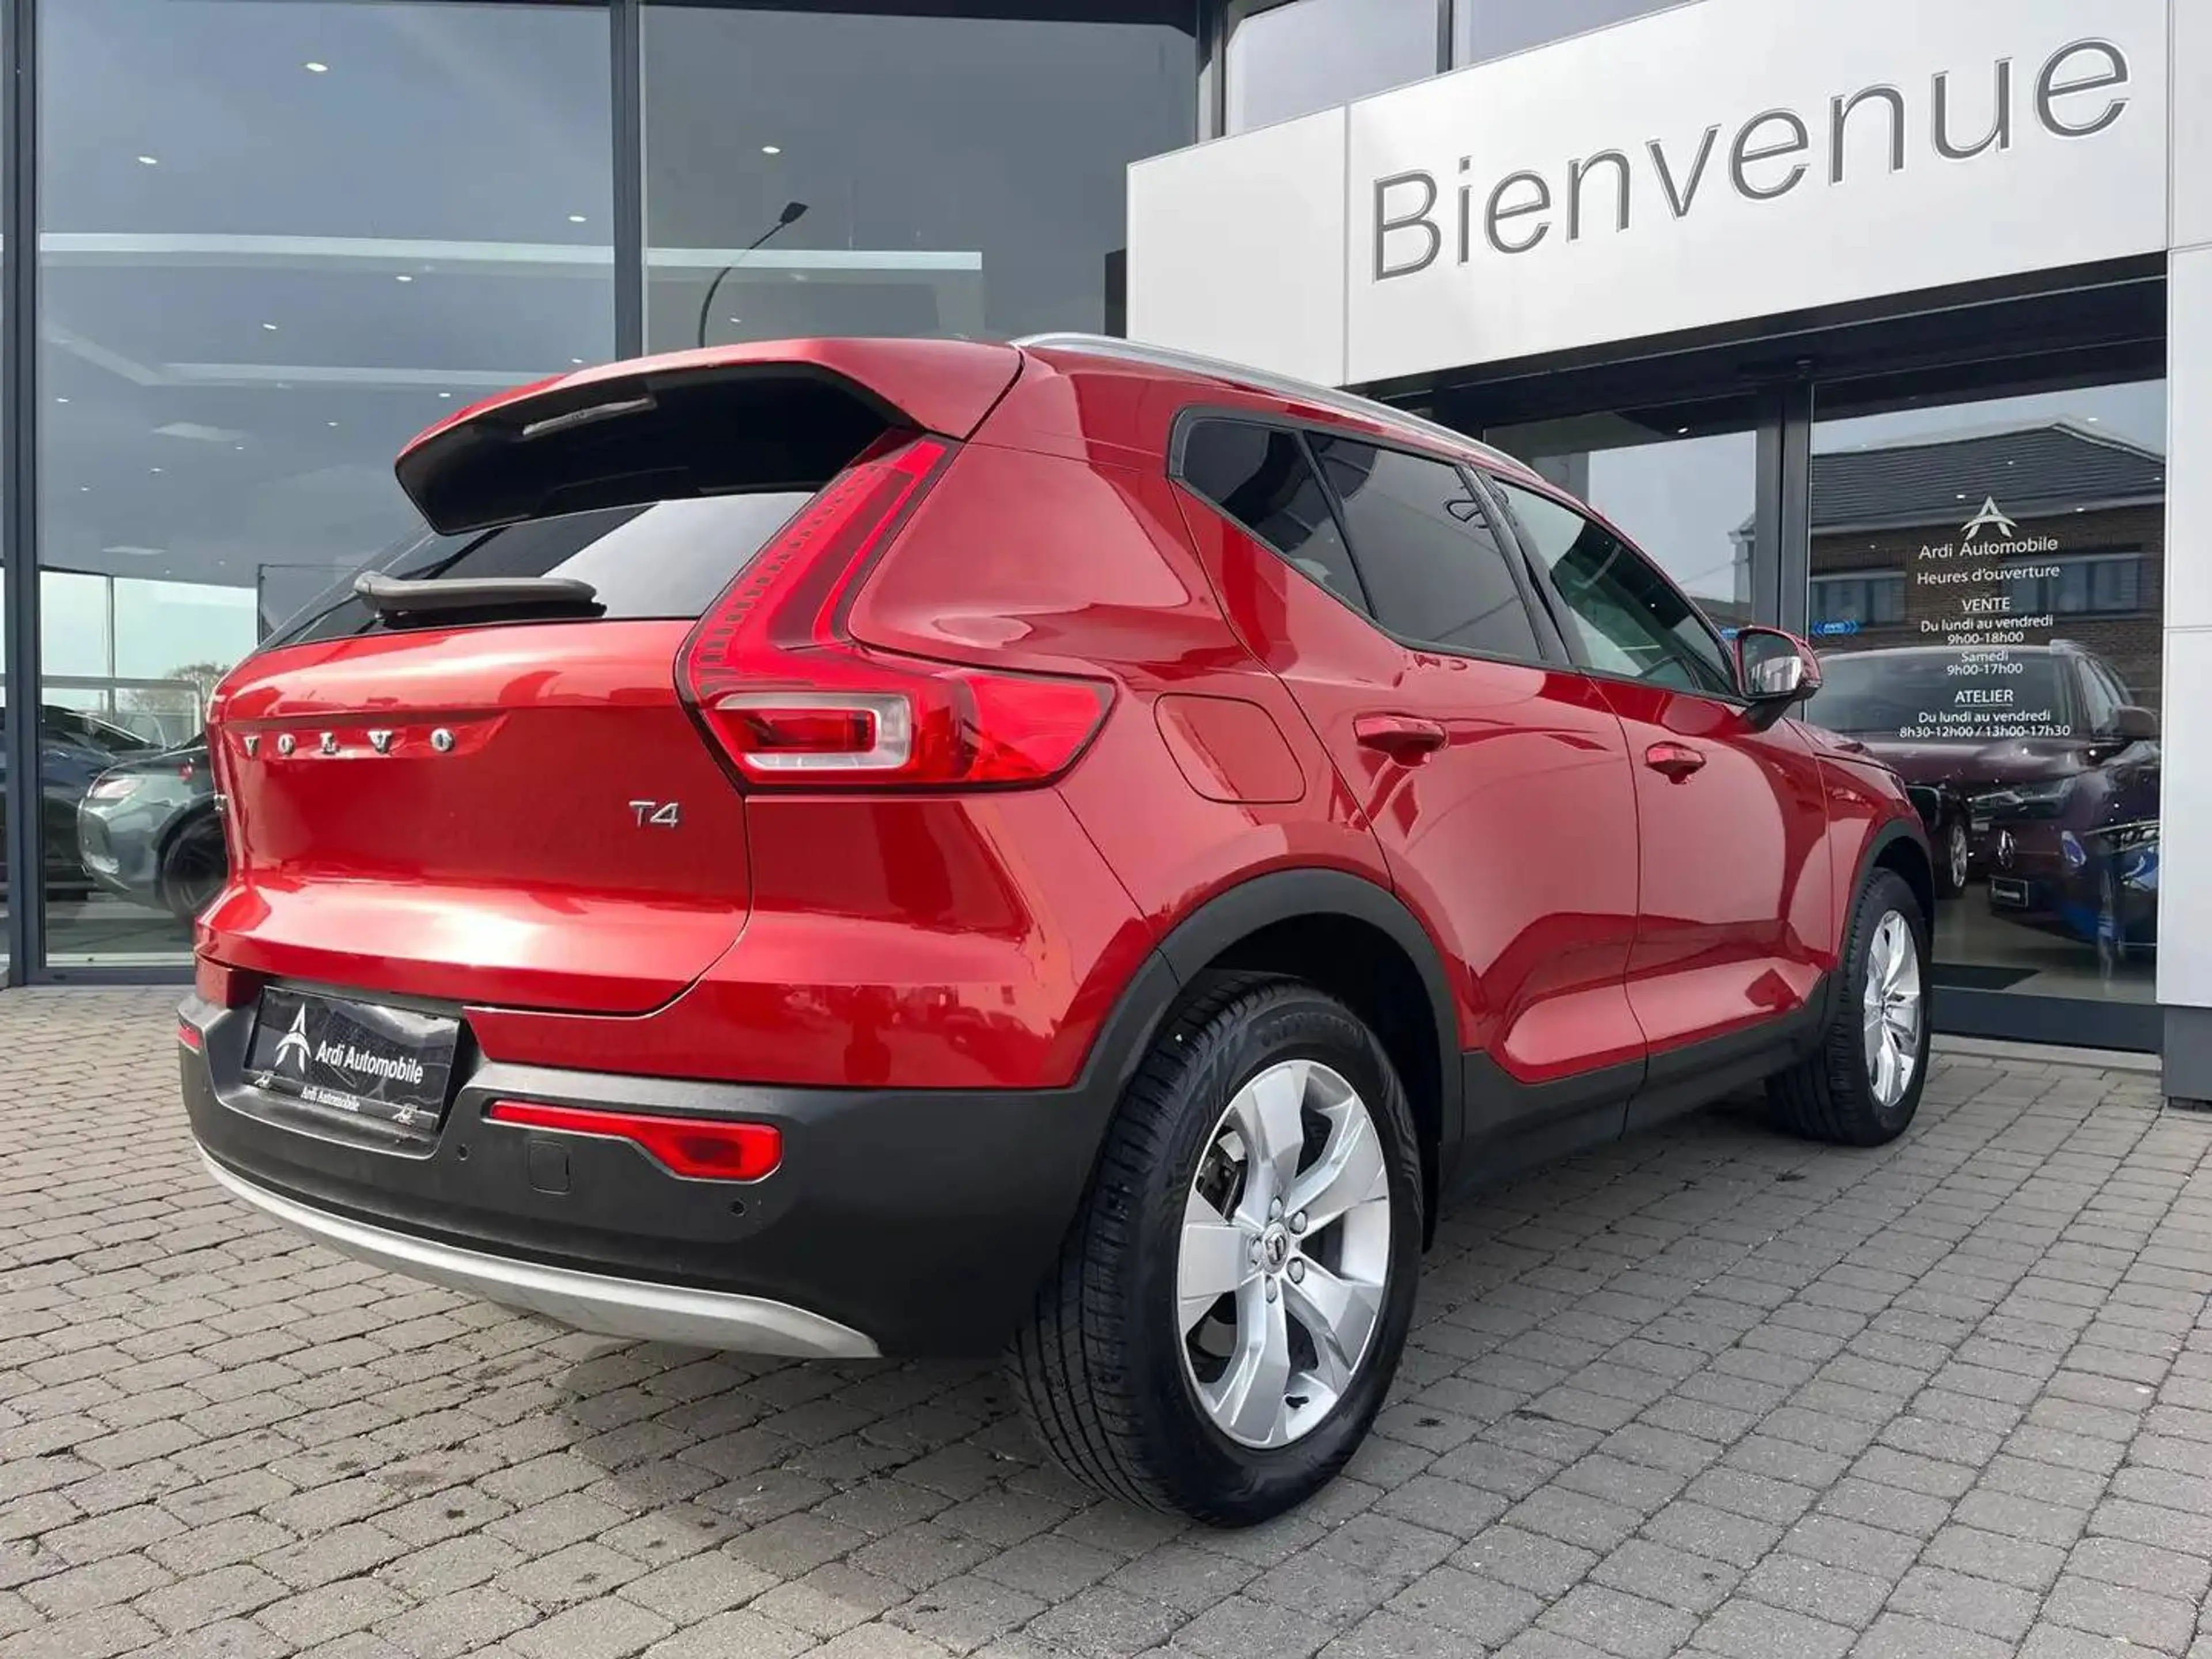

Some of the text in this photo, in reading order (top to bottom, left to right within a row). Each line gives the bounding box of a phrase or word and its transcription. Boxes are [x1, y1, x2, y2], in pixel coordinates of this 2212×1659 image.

[1372, 36, 2130, 283] Bienvenue
[1919, 536, 2058, 559] Ardi Automobile
[1917, 571, 1969, 584] Heures
[1962, 597, 2010, 611] VENTE
[1922, 615, 2053, 632] Du lundi au vendredi
[1948, 631, 2024, 645] 9h00-18h00
[1961, 650, 2009, 662] Samedi
[1947, 664, 2023, 676] 9h00-17h00
[1955, 689, 2014, 703] ATELIER
[1918, 709, 2051, 723] Du lundi au vendredi
[243, 728, 456, 756] VOLVO
[628, 800, 679, 828] T4
[315, 1040, 423, 1084] Ardi Automobile
